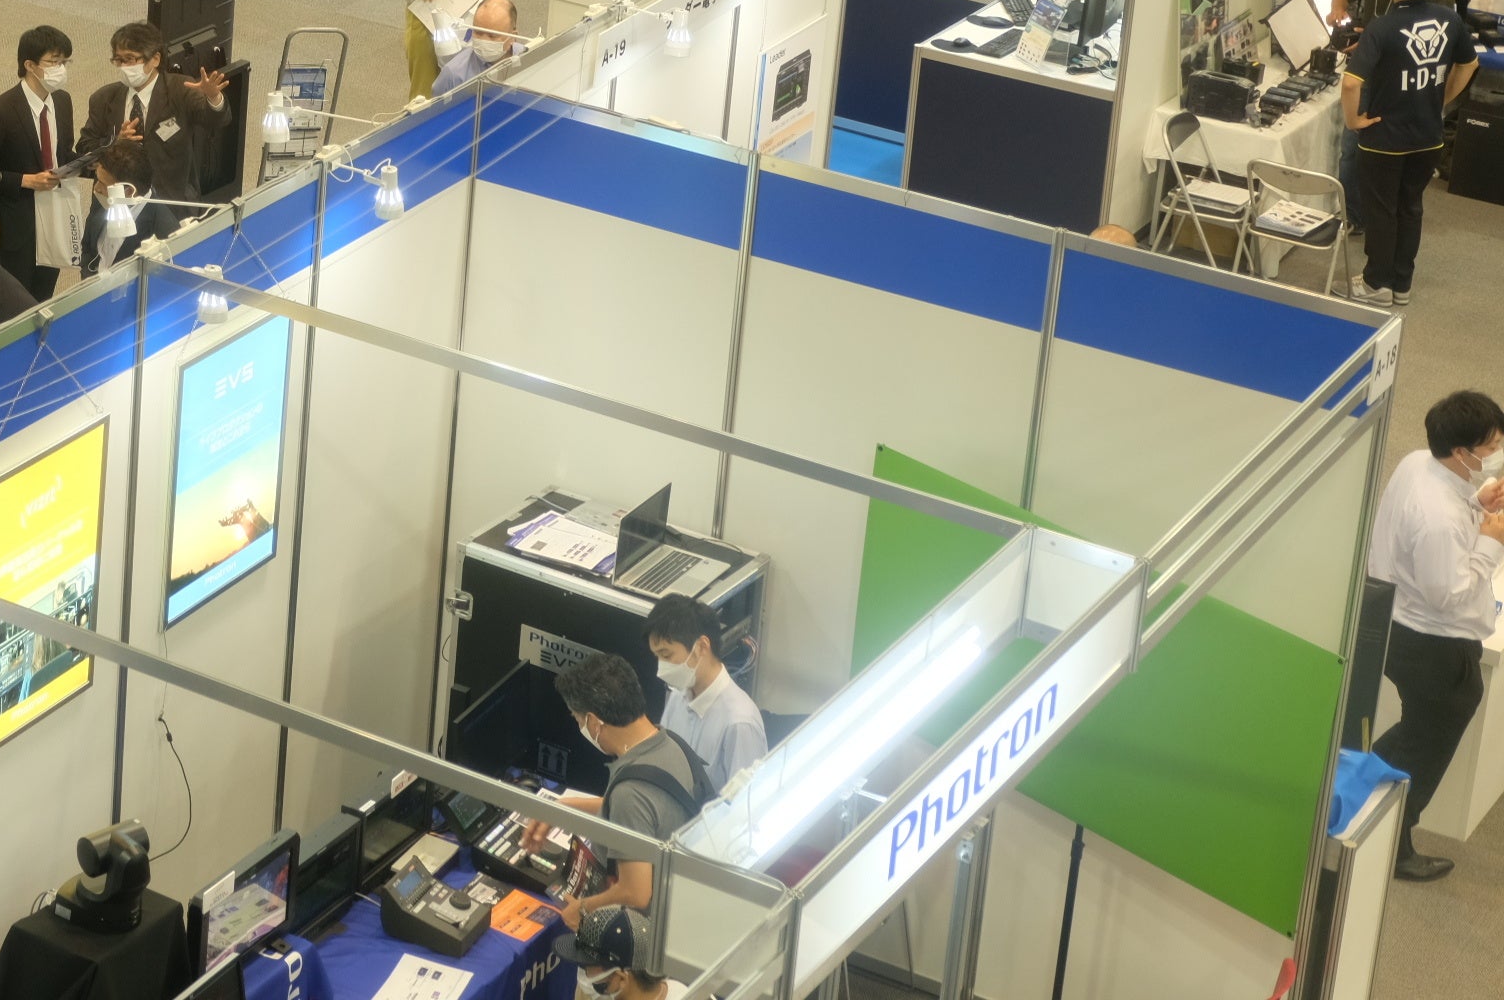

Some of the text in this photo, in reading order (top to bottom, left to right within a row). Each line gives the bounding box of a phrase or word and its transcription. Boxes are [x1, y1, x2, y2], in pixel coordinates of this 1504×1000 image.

[601, 38, 627, 68] A-19
[214, 360, 254, 400] EVS
[1374, 343, 1398, 382] A-18
[529, 631, 589, 660] Photro
[887, 681, 1059, 882] Photron
